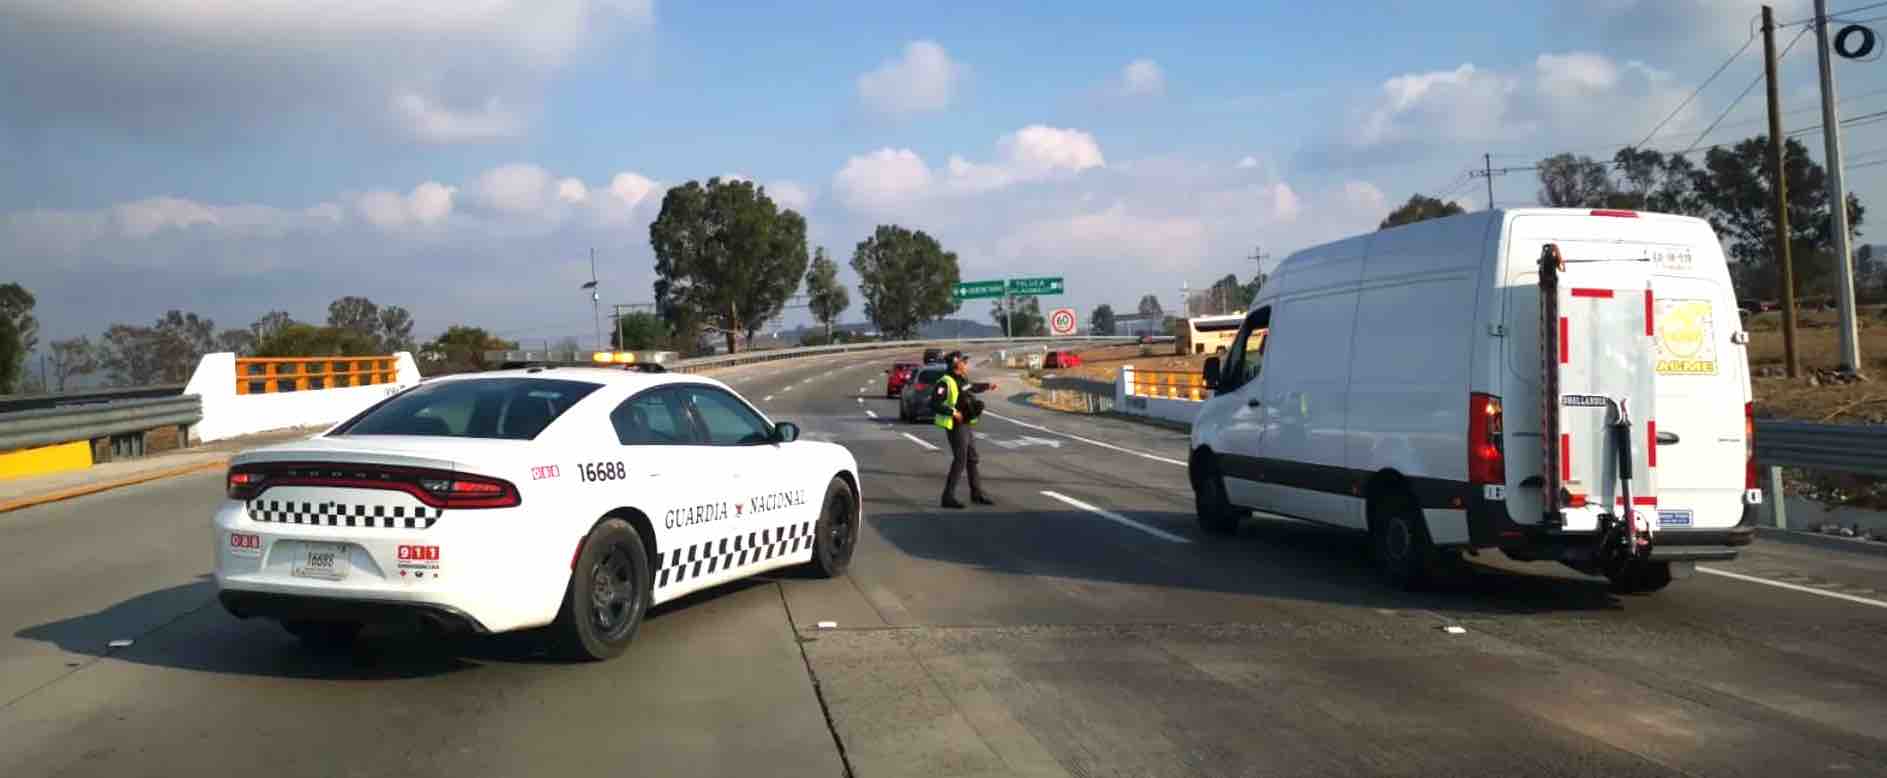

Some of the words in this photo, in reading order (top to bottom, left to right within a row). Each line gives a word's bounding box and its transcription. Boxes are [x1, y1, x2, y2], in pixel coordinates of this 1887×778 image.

[1057, 315, 1069, 325] 60
[1656, 360, 1713, 372] ACME
[577, 461, 626, 483] 16688
[665, 502, 728, 529] GUARDIA
[749, 489, 807, 515] NACIONAL
[399, 546, 437, 558] 911
